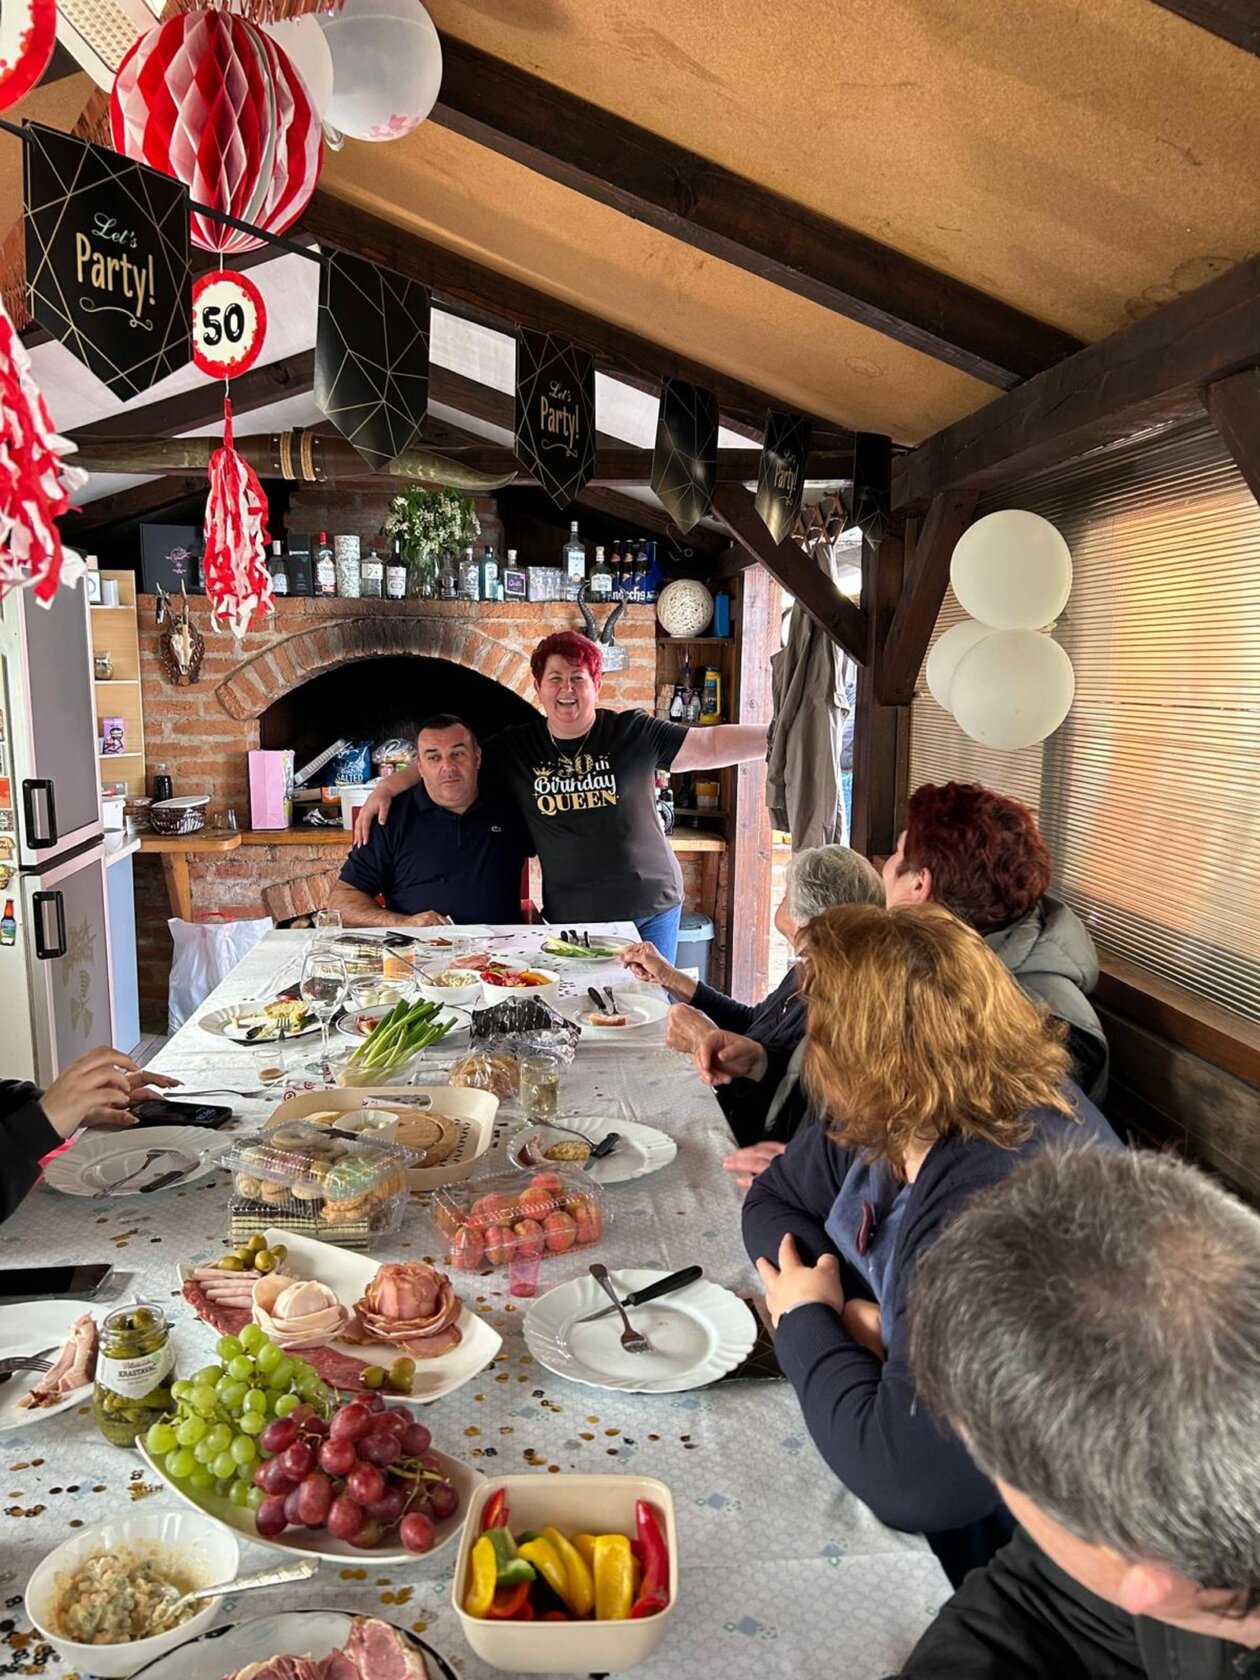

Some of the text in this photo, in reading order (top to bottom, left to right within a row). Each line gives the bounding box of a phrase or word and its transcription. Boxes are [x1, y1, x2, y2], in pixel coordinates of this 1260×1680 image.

[92, 212, 138, 248] Let's
[76, 232, 156, 317] Party!
[202, 302, 246, 347] 50
[540, 395, 580, 449] Party!
[335, 771, 364, 782] SALTED
[534, 772, 617, 795] Birthday
[537, 789, 617, 816] QUEEN
